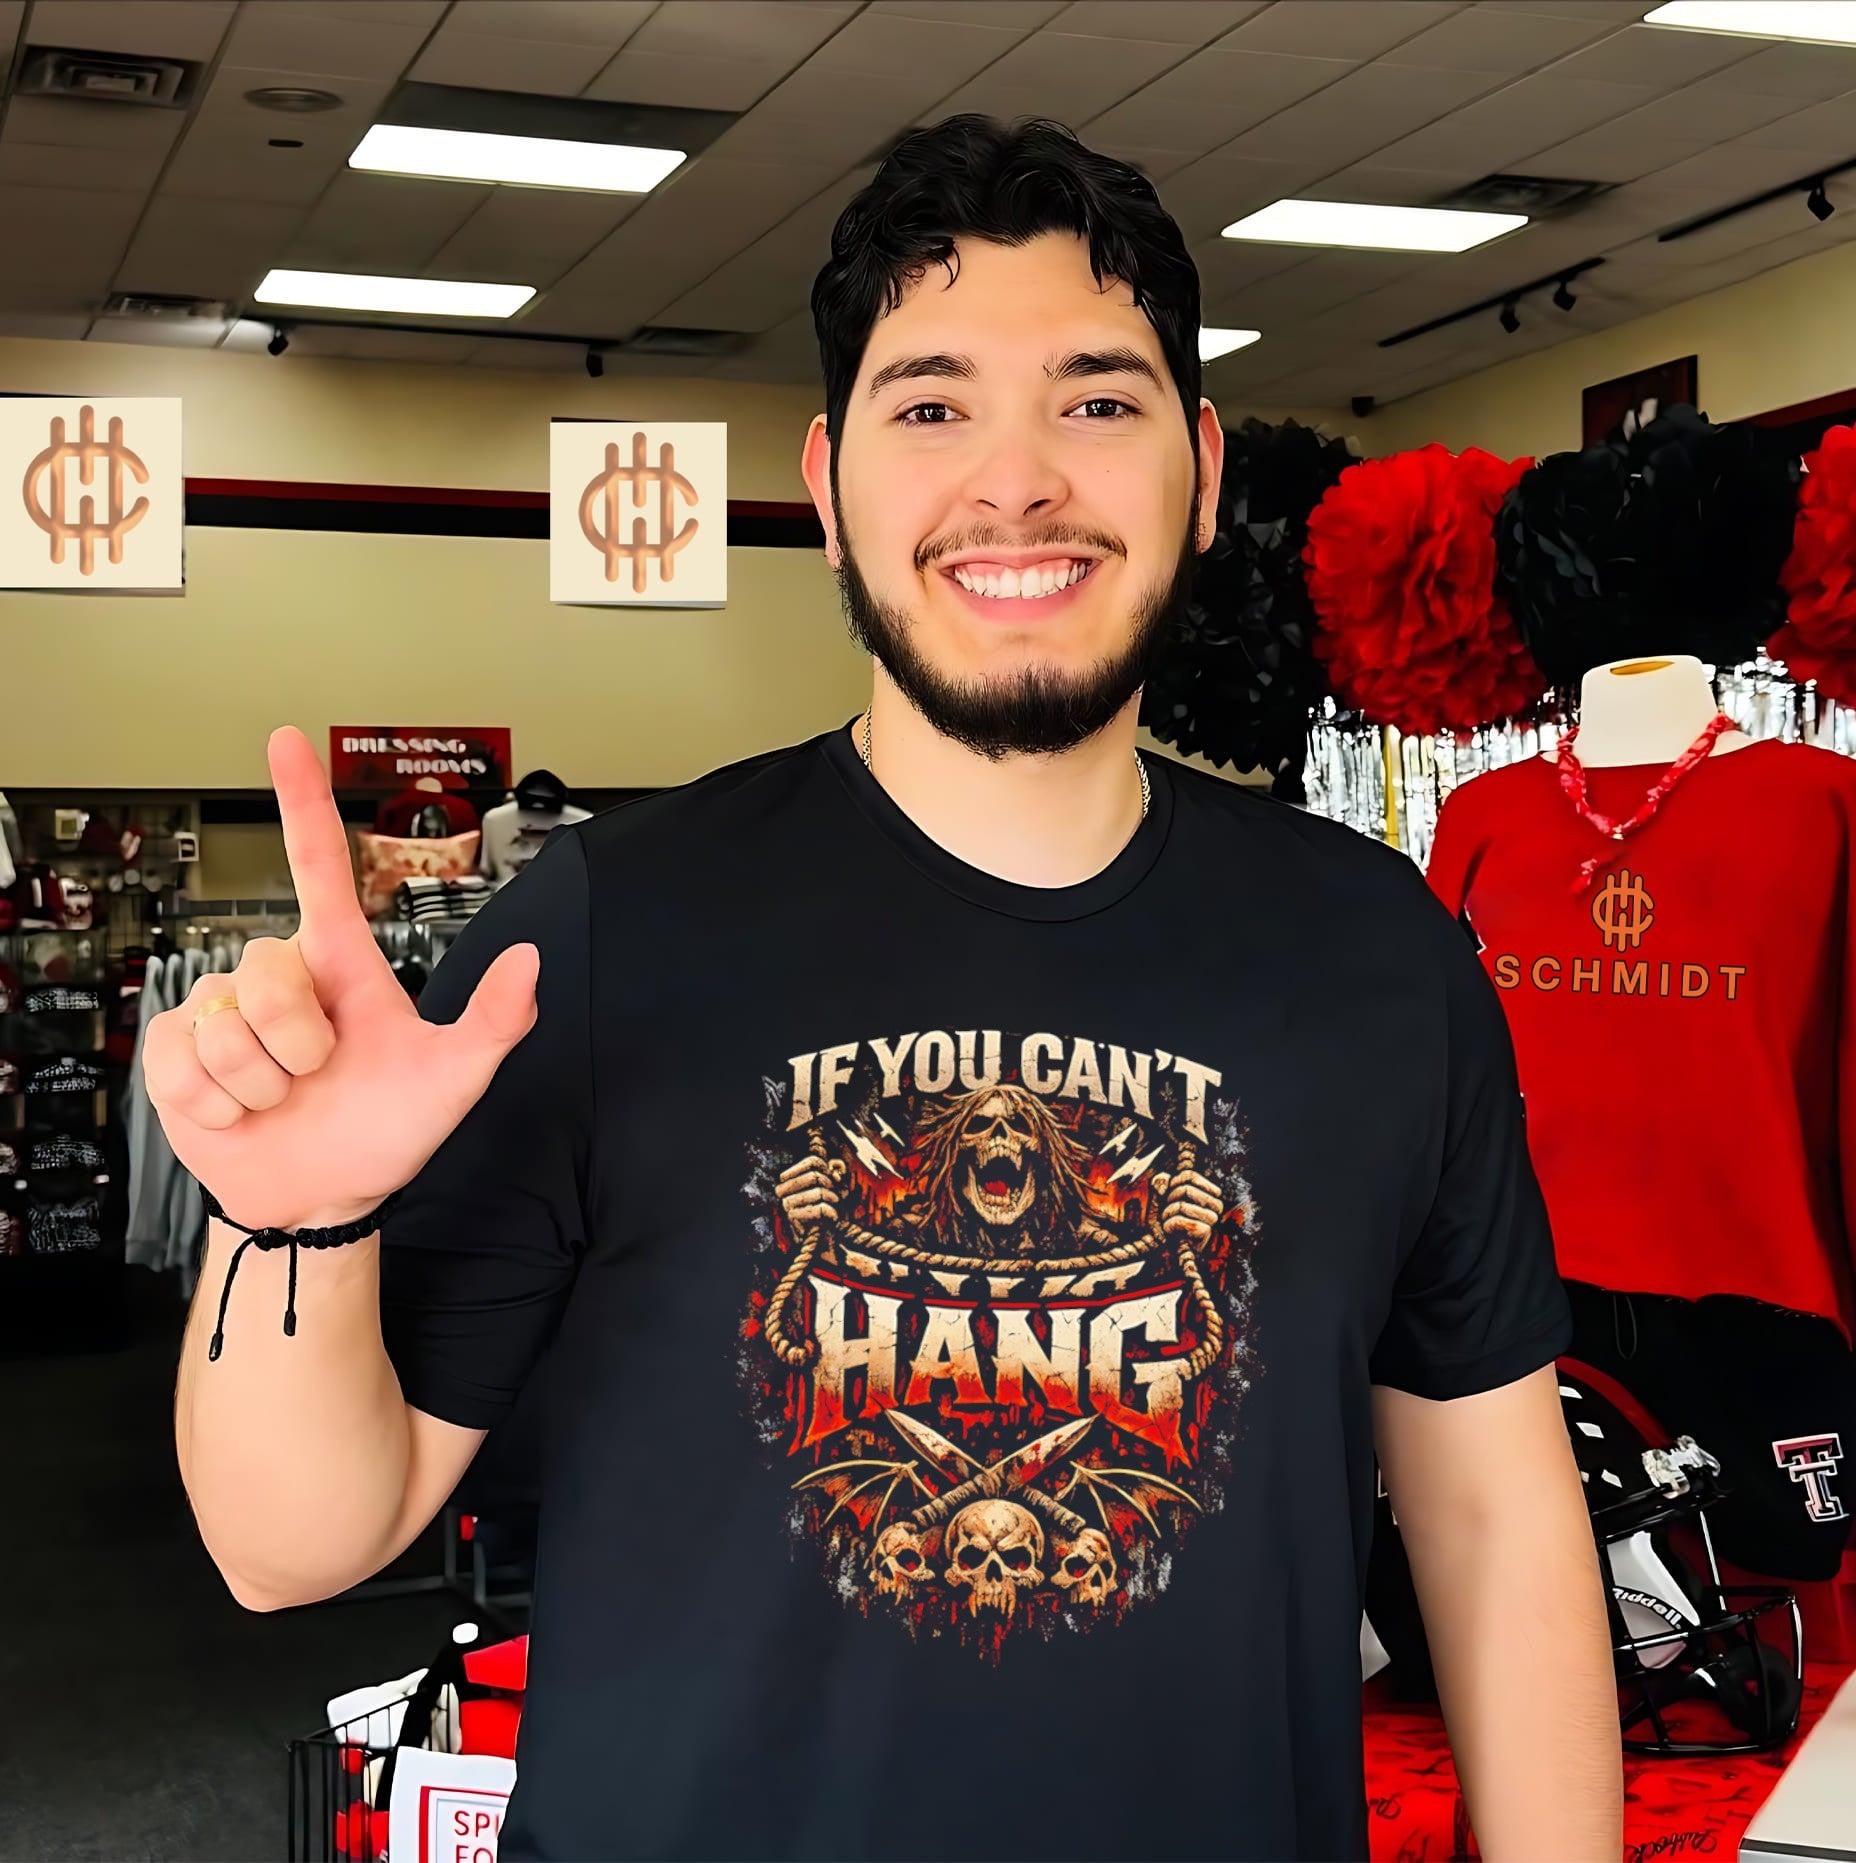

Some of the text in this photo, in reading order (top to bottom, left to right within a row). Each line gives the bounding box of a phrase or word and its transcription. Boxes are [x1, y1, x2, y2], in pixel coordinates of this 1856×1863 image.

[341, 737, 467, 754] DRESSING
[396, 758, 487, 775] ROOMS
[1493, 954, 1747, 1000] SCHMIDT
[786, 1030, 1223, 1144] IF YOU CAN'T
[806, 1274, 1192, 1468] HANG
